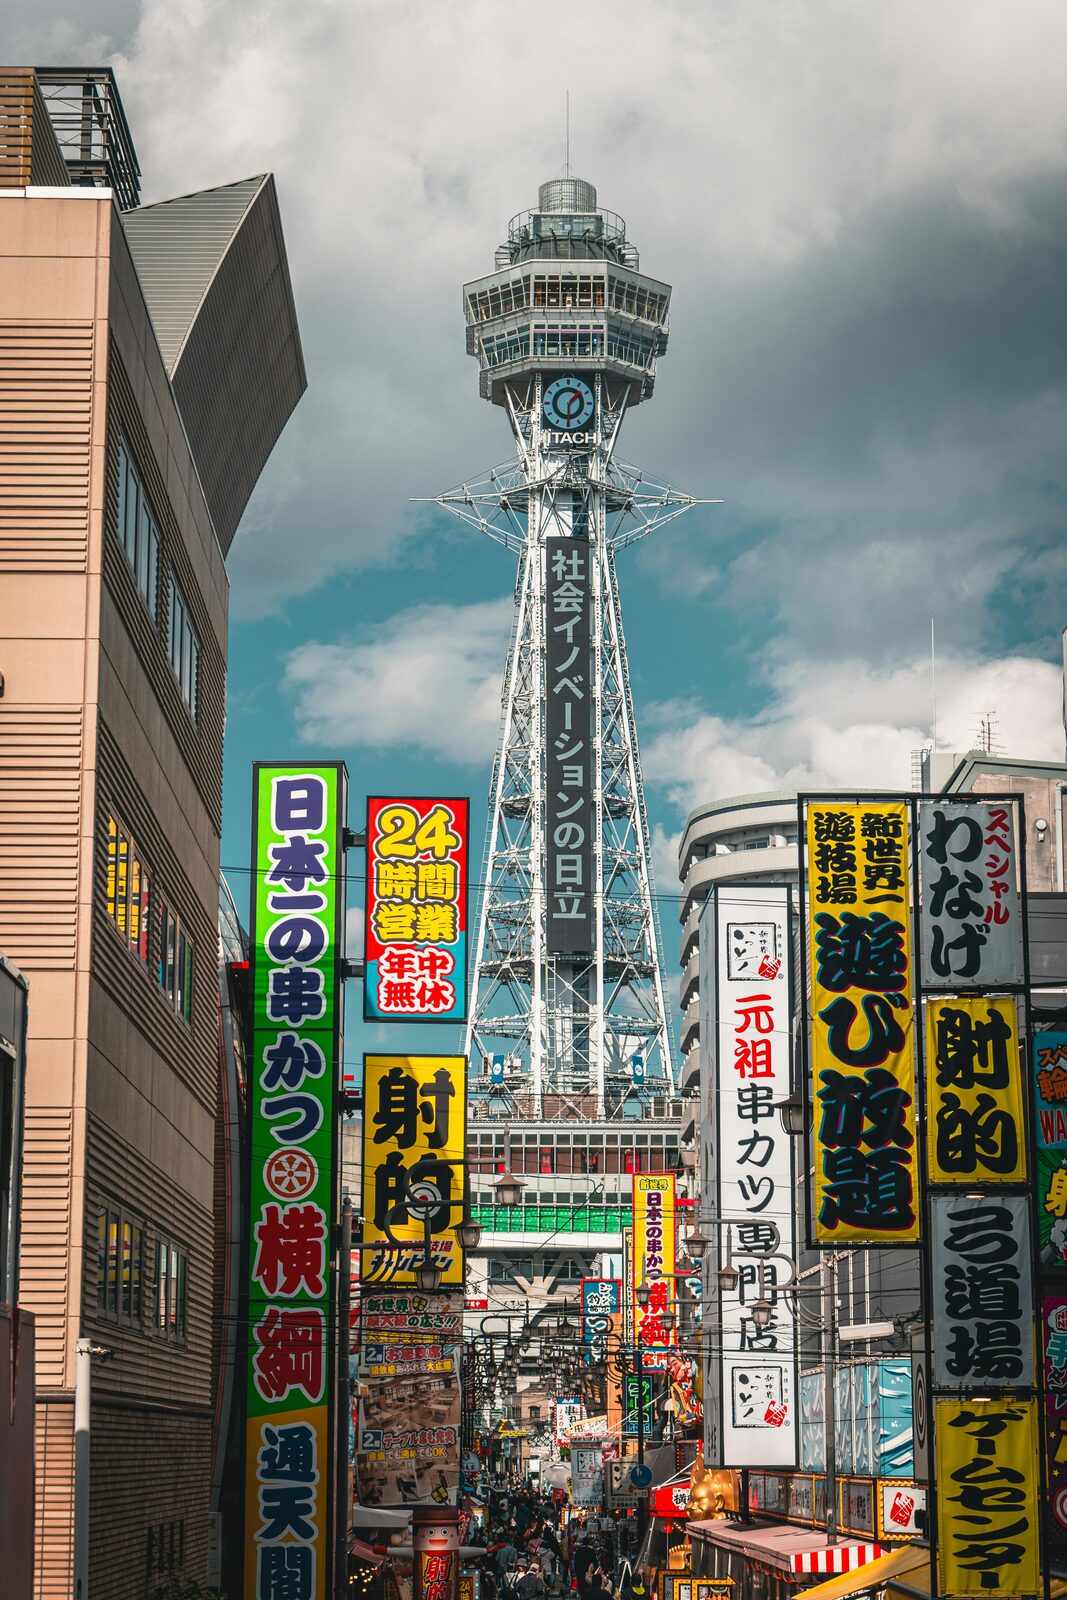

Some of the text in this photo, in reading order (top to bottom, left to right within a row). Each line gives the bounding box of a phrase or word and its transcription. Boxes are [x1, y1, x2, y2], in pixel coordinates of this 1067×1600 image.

[551, 549, 587, 919] 社会イノベーションの日立
[377, 861, 457, 899] 時間
[378, 807, 459, 858] 24
[983, 809, 1012, 925] スペシャル
[376, 903, 457, 941] 営業
[926, 810, 991, 978] わなげ
[264, 775, 327, 1144] 日本一の串かつ
[380, 949, 455, 979] 年中
[380, 980, 455, 1011] 無休
[814, 911, 916, 1231] 遊び放題
[937, 1007, 1018, 1174] 射的
[1038, 1108, 1067, 1145] WA
[372, 1066, 456, 1233] 射的
[734, 993, 779, 1351] 元祖串カツ専門店
[645, 1192, 663, 1280] 日本一の串かつ
[254, 1203, 326, 1402] 横綱
[367, 1299, 408, 1312] 新世界
[639, 1281, 670, 1347] 横綱
[944, 1408, 1030, 1589] ゲームセンター
